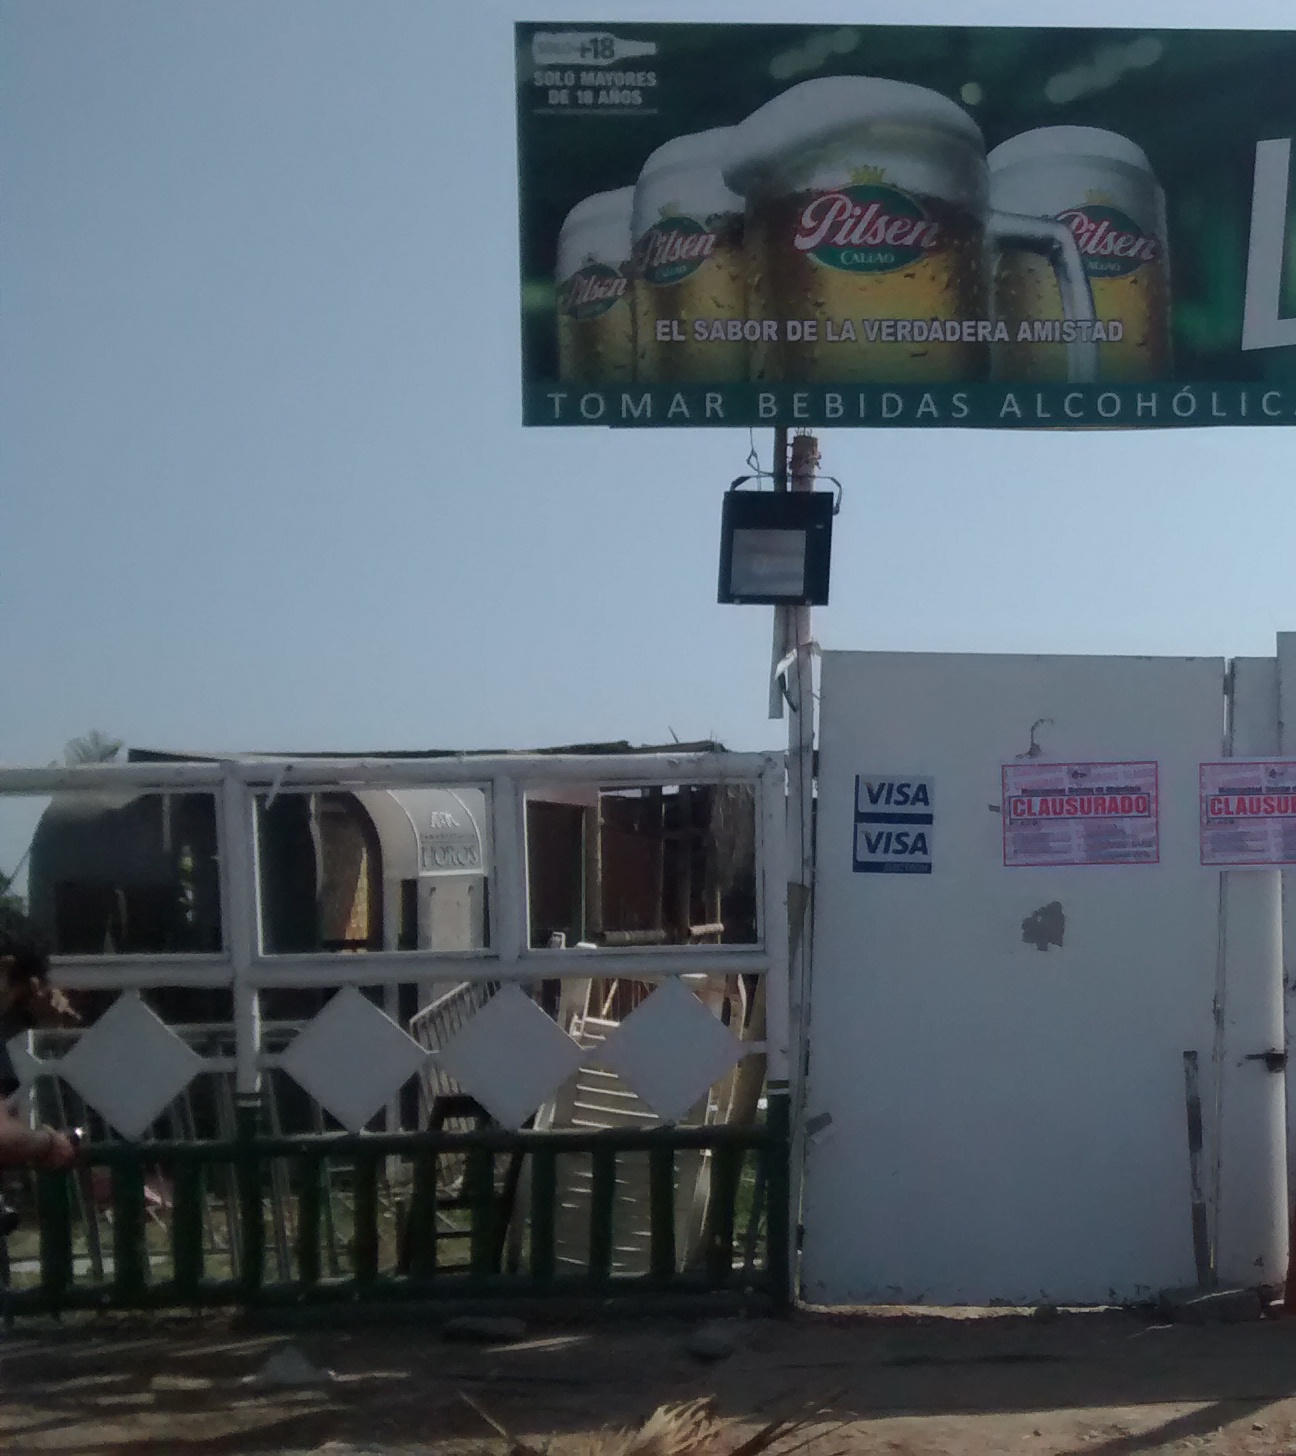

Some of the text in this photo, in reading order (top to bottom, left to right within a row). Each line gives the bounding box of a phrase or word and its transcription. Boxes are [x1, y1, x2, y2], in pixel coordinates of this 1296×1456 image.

[533, 71, 657, 87] SOLO MAYORES
[548, 89, 570, 105] DE
[793, 193, 940, 250] Pilsen
[655, 319, 1124, 342] EL SABOR DE LA VERDADERA AMISTAD
[547, 392, 724, 419] TOMAR
[758, 391, 969, 419] BEBIDAS
[865, 782, 930, 806] VISA
[1011, 795, 1148, 817] CLAUSURADO
[863, 831, 928, 855] VISA
